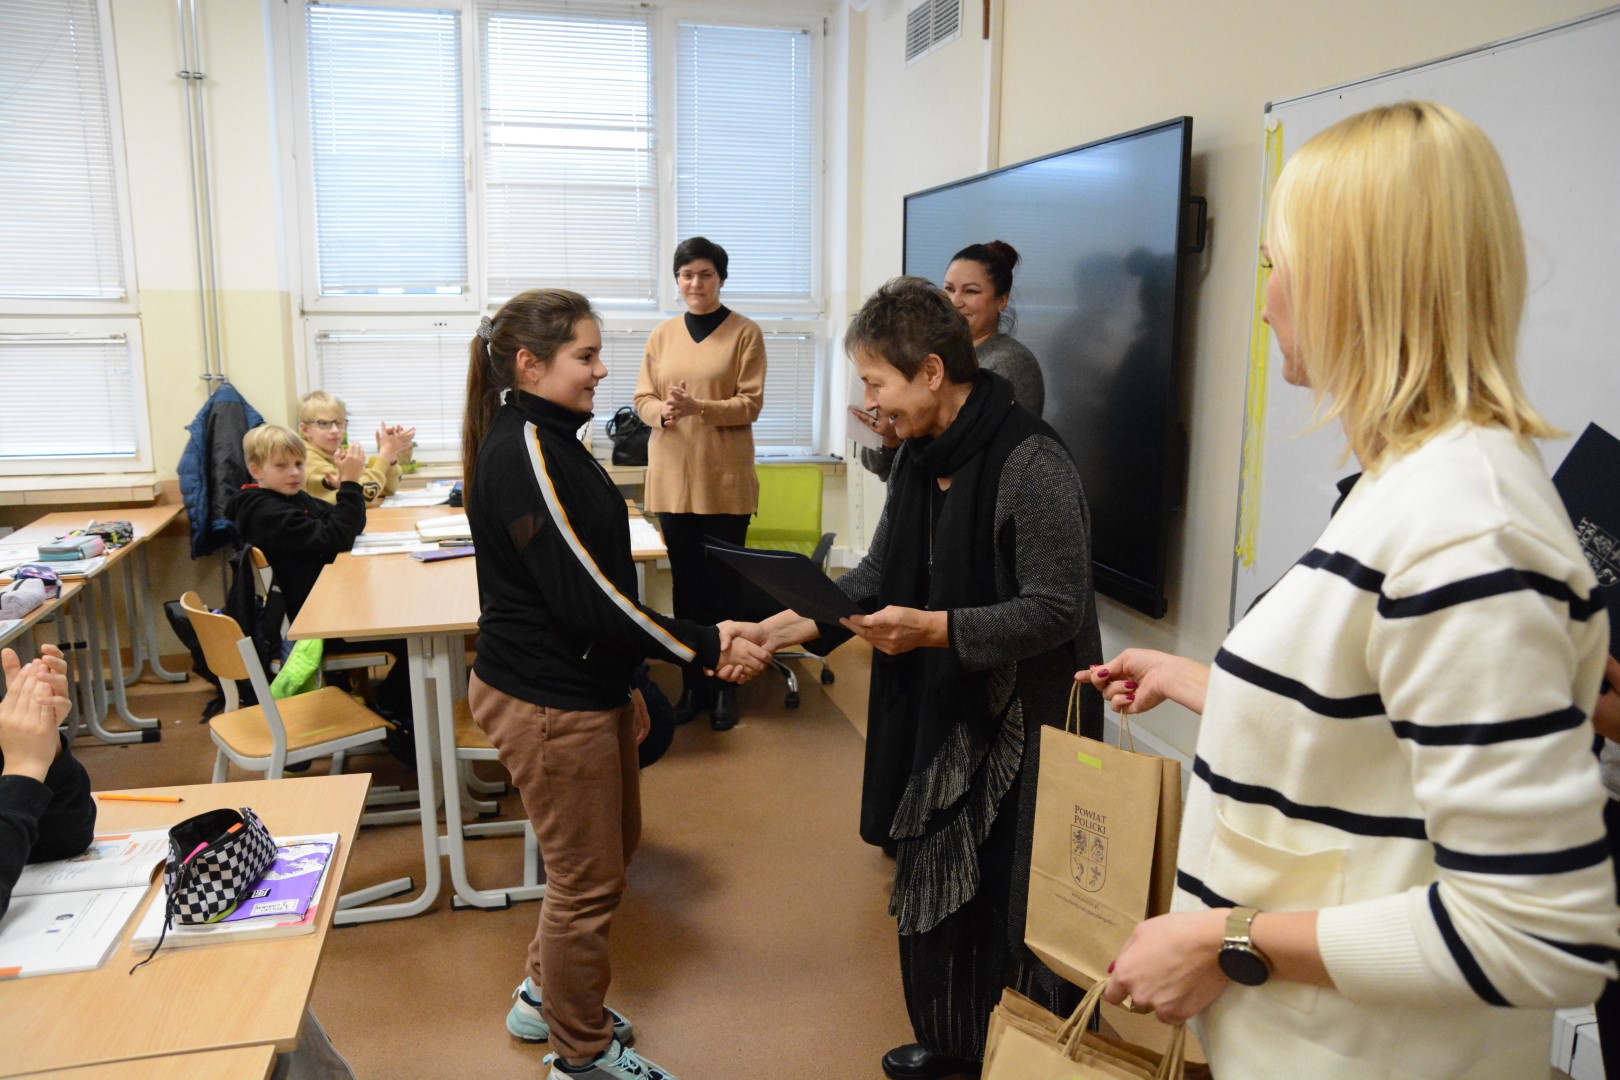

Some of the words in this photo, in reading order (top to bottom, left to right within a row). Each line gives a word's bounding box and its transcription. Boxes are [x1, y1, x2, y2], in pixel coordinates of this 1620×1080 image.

[1574, 517, 1589, 537] IAT
[1579, 522, 1598, 547] ICKI
[1074, 804, 1106, 824] POWIAT
[1074, 814, 1106, 835] POLICKI
